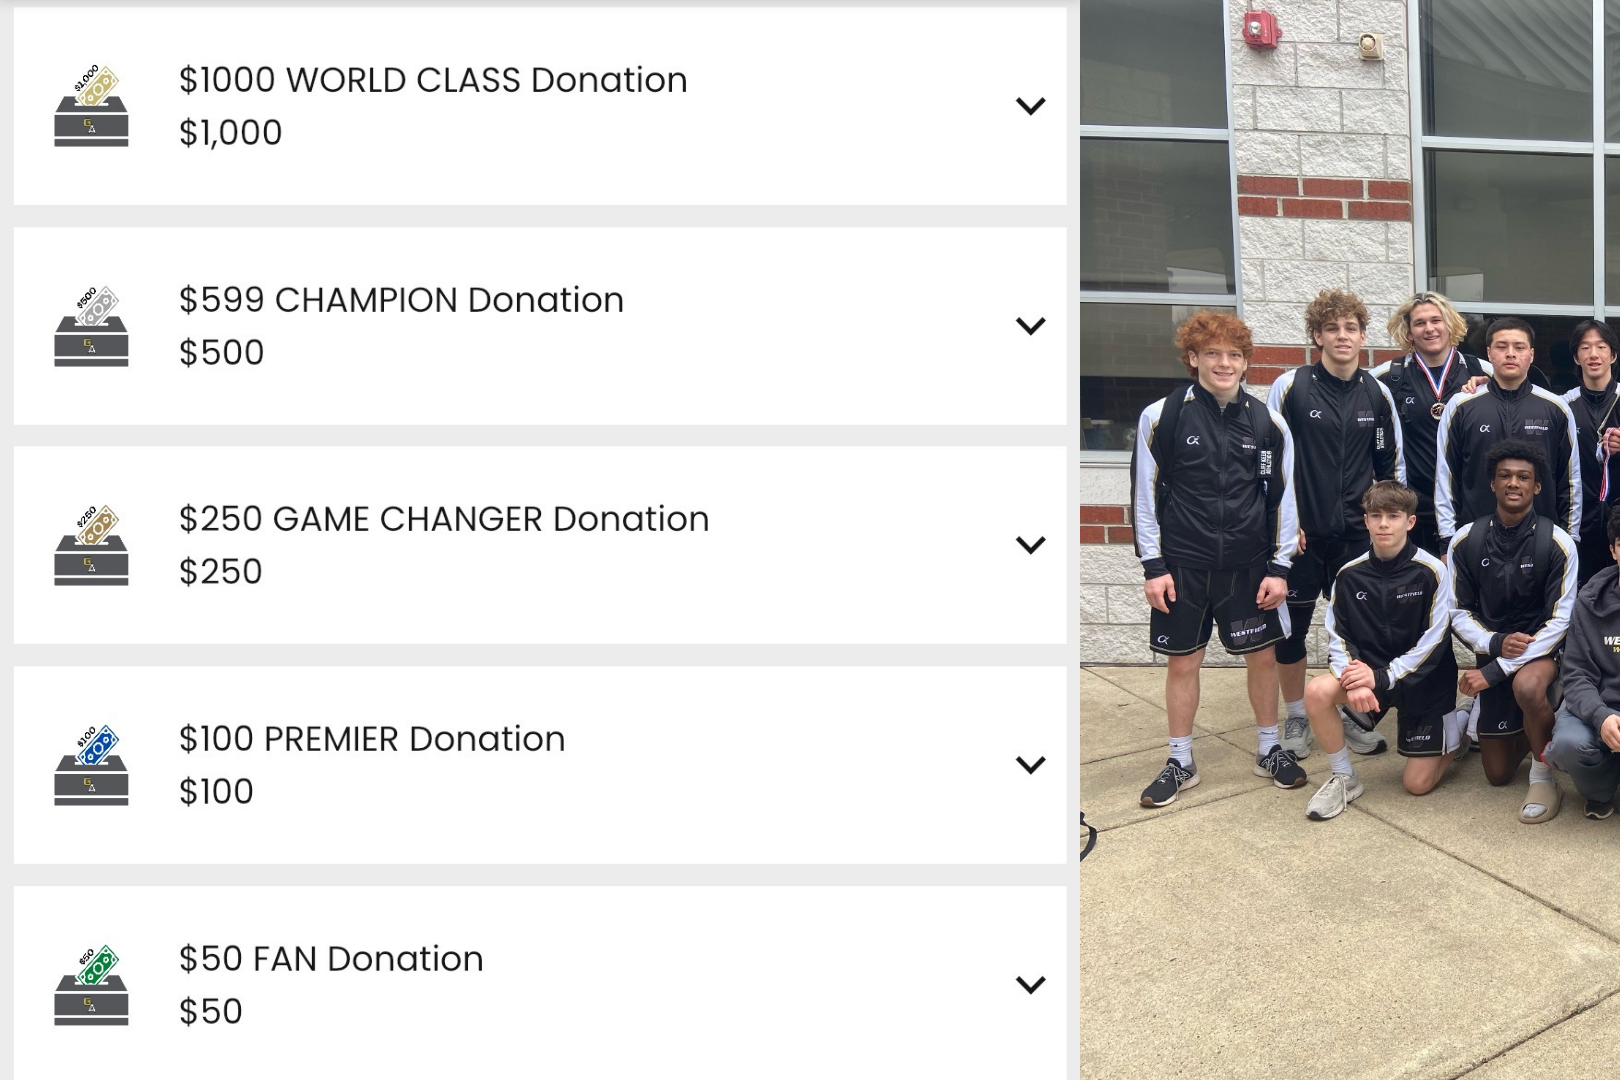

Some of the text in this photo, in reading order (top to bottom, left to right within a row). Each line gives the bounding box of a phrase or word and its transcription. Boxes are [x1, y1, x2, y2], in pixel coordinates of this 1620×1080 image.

[180, 64, 687, 96] $1000 WORLD CLASS Donation
[180, 117, 282, 151] $1,000
[180, 284, 623, 316] $599 CHAMPION Donation
[180, 337, 264, 369] $500
[180, 503, 709, 535] $250 GAME CHANGER Donation
[180, 556, 262, 588] $250
[180, 723, 565, 755] $100 PREMIER Donation
[180, 775, 253, 808] $100
[180, 943, 483, 975] $50 FAN Donation
[180, 995, 242, 1027] $50
